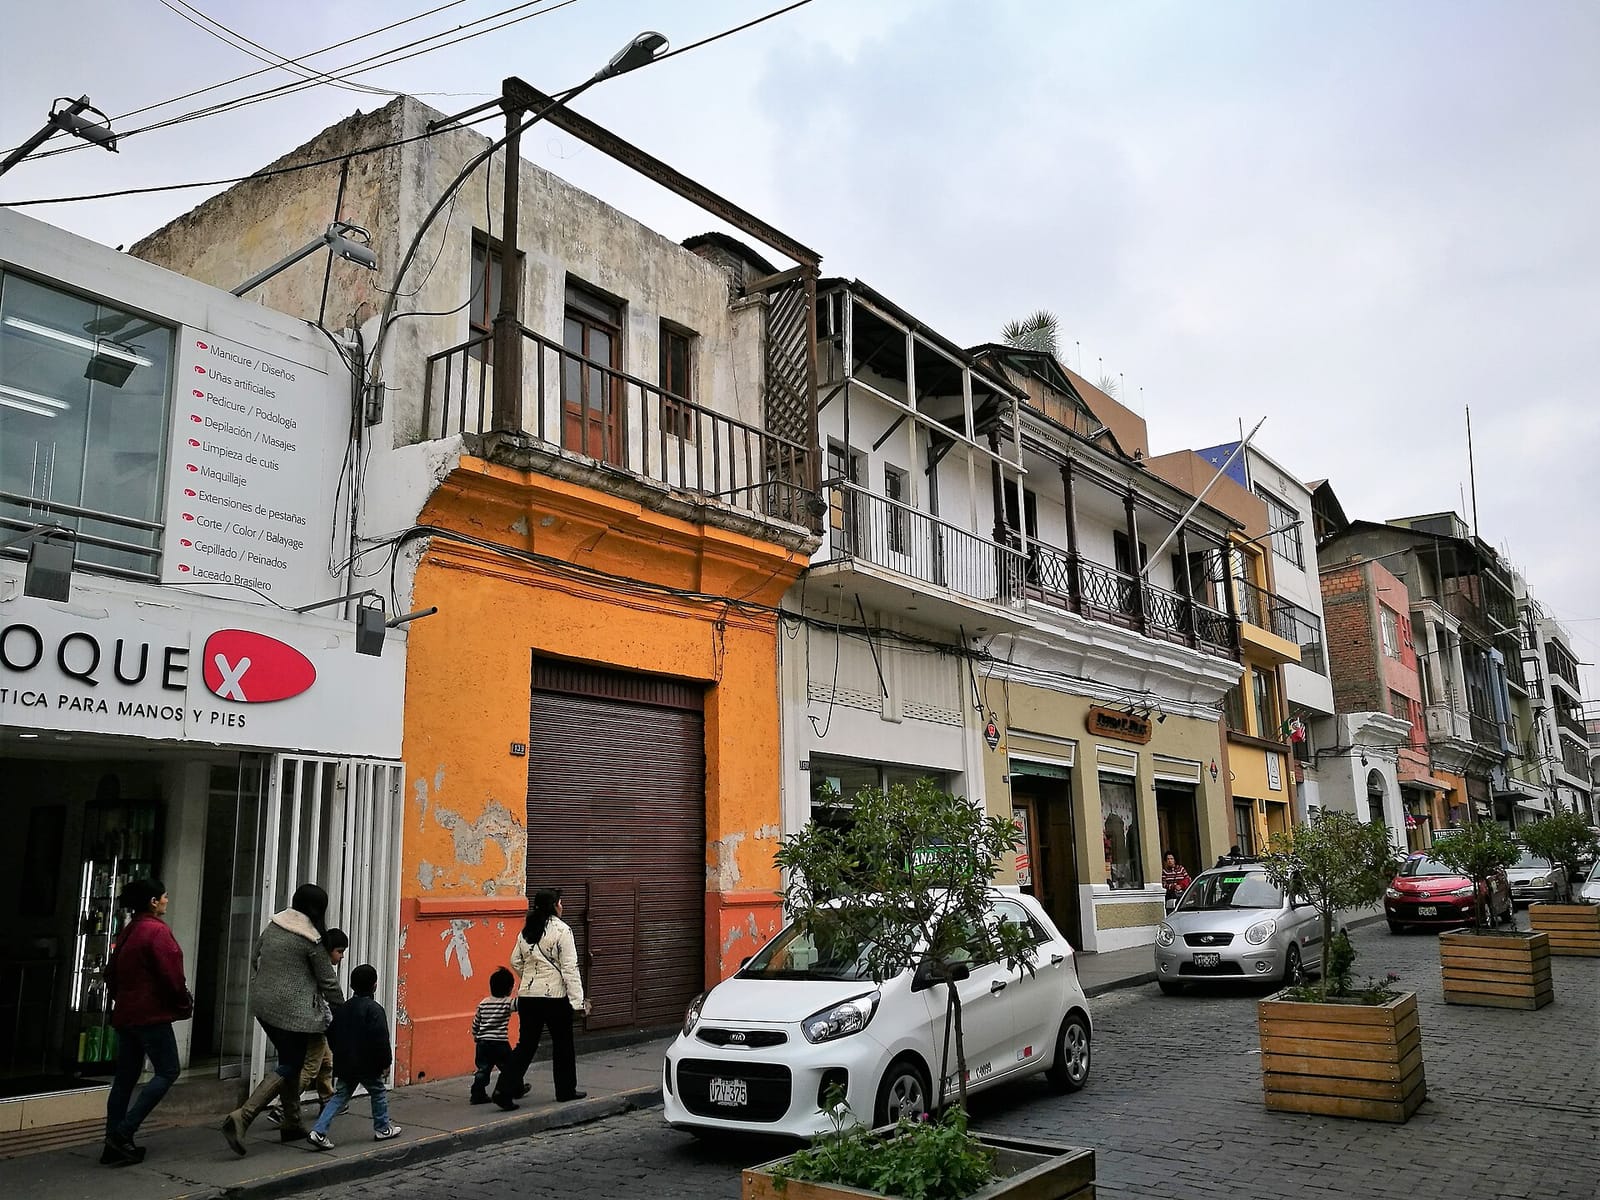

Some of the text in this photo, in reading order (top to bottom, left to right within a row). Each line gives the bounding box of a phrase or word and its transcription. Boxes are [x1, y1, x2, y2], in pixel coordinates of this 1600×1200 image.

[210, 345, 252, 367] Manicure
[261, 362, 296, 382] Diseños
[208, 368, 276, 399] Uñas artificiales
[206, 392, 246, 413] Pedicure
[204, 416, 252, 439] Depilación
[261, 433, 296, 452] Masajes
[202, 441, 280, 471] Limpieza de cutis
[200, 466, 247, 487] Maquillaje
[198, 490, 306, 526] Extensiones de pestañas
[196, 515, 223, 530] Corte
[232, 523, 257, 538] Color
[266, 531, 304, 551] Balayage
[194, 540, 238, 559] Cepillado
[247, 551, 288, 569] Peinados
[192, 565, 272, 591] Laceado Brasilero
[0, 688, 246, 728] TICA PARA MANOS Y PIES
